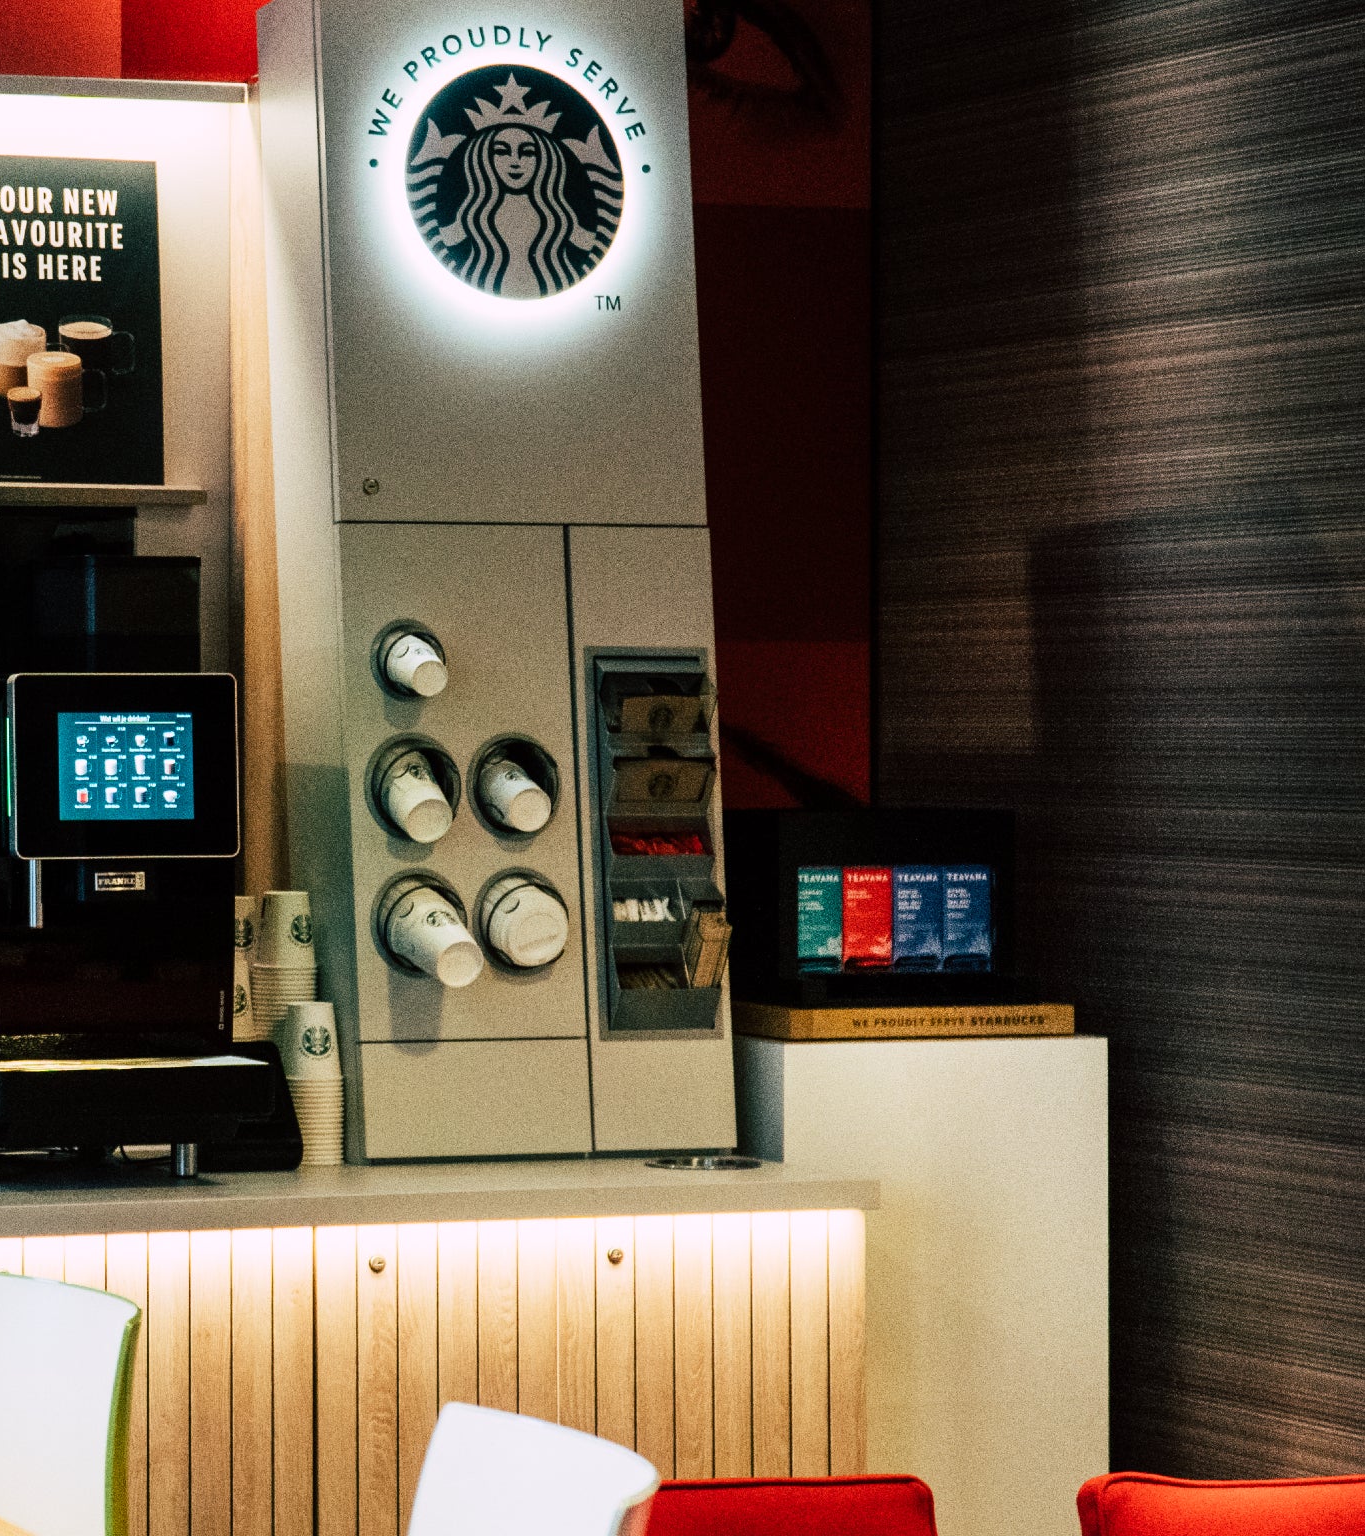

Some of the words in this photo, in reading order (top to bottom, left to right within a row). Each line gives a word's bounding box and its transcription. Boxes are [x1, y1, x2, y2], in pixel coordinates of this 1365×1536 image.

[368, 89, 403, 136] WE
[402, 25, 552, 82] PROUDLY
[566, 48, 646, 141] SERVE
[63, 188, 117, 216] NEW
[2, 252, 27, 280] IS
[38, 254, 102, 281] HERE
[594, 295, 621, 310] TM
[798, 874, 839, 882] TEAVANA
[847, 874, 888, 882] TEAVANA
[898, 874, 938, 882] TEAVANA
[947, 873, 987, 881] TEAVANA
